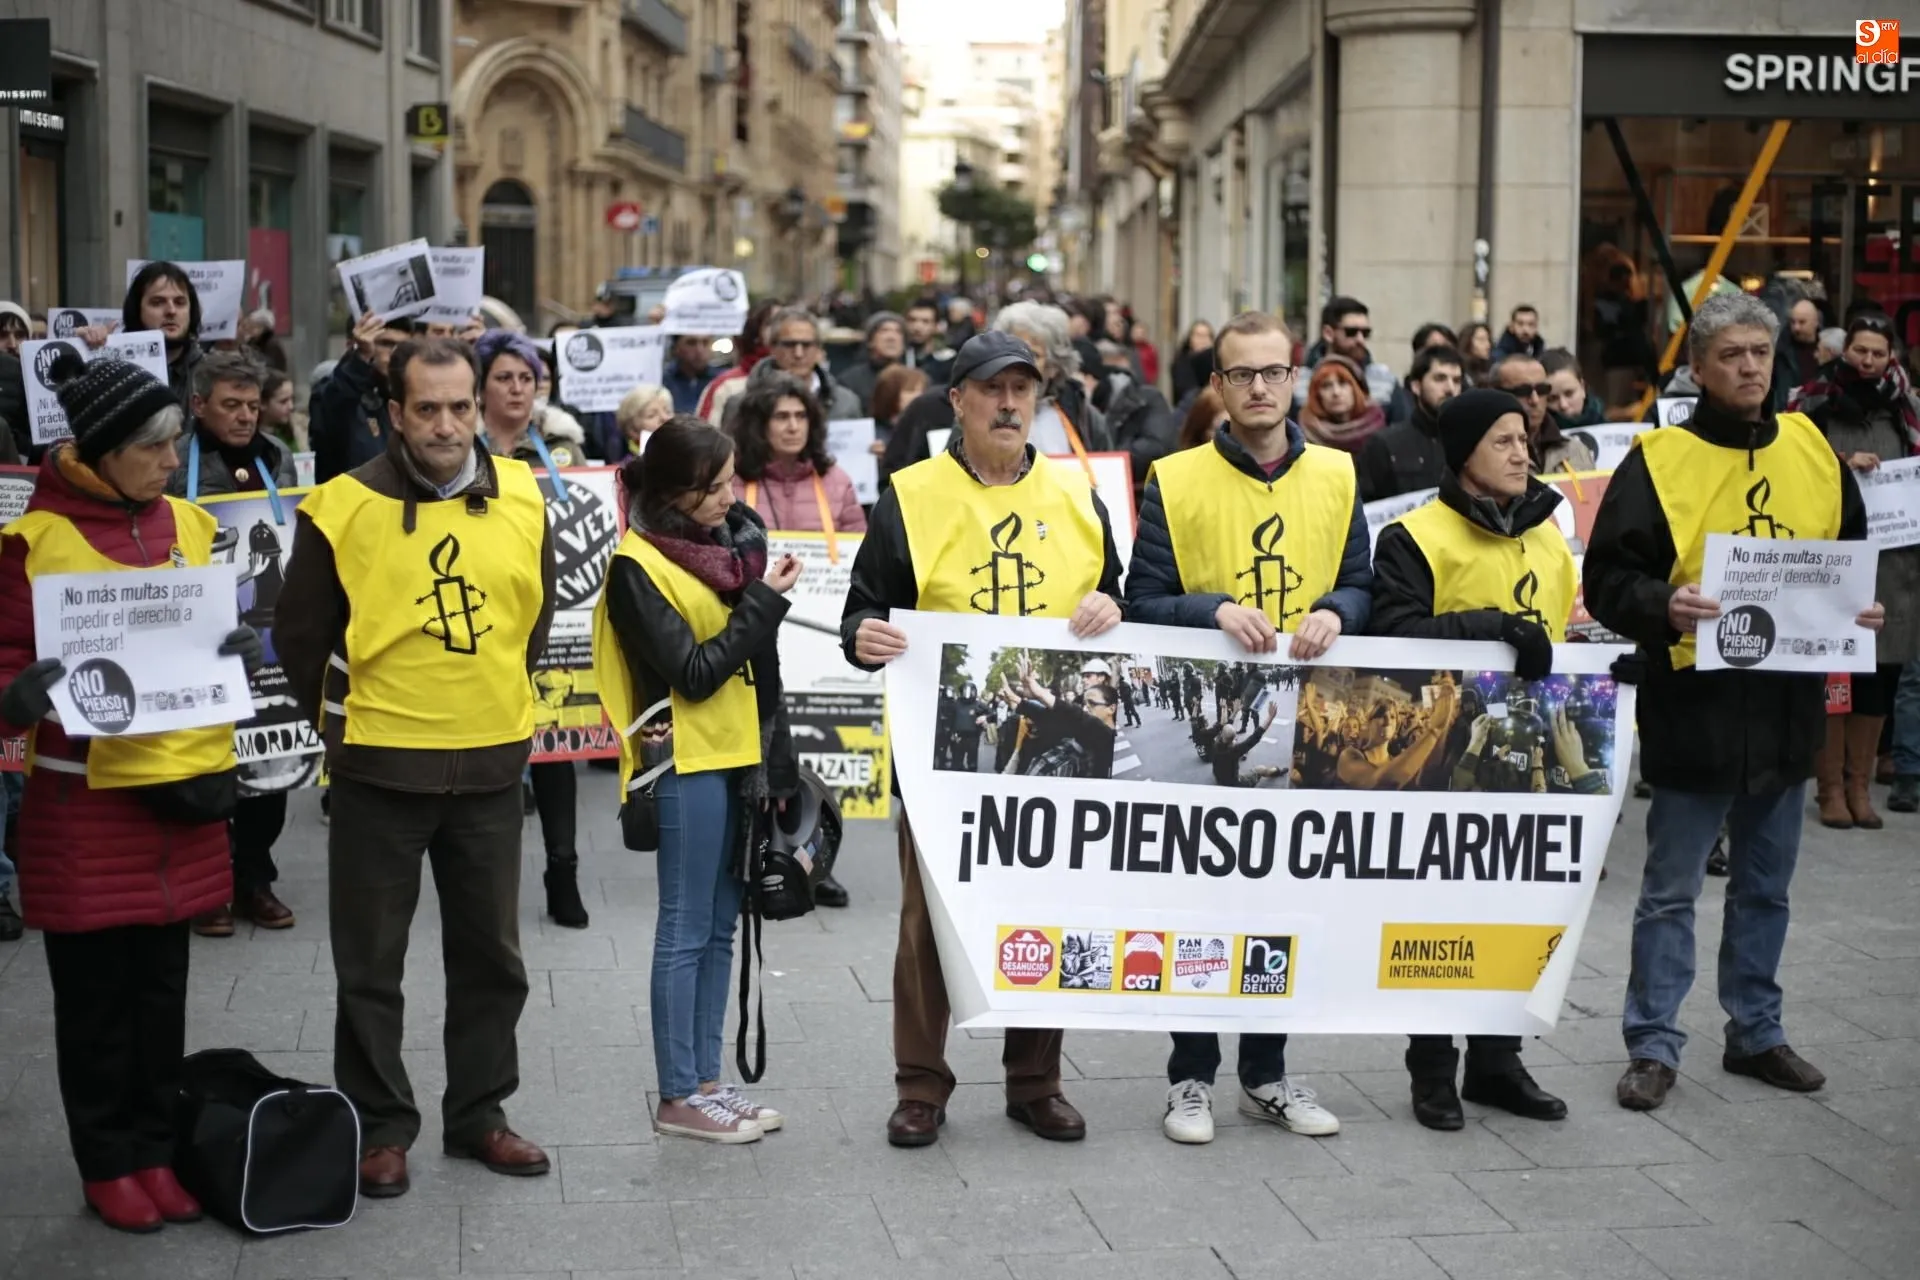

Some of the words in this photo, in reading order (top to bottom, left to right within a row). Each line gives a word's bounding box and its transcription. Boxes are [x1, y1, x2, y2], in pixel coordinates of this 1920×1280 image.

[1726, 547, 1750, 567] ¡No
[1753, 548, 1779, 564] más
[1782, 549, 1823, 566] multas
[1825, 554, 1852, 569] para
[1724, 568, 1770, 585] impedir
[1772, 568, 1782, 583] el
[1785, 567, 1830, 585] derecho
[1832, 573, 1841, 585] a
[60, 586, 83, 612] ¡No
[87, 584, 117, 604] más
[120, 582, 169, 602] multas
[172, 583, 203, 603] para
[1720, 586, 1778, 604] protestar!
[60, 611, 109, 632] impedir
[112, 610, 125, 627] el
[127, 605, 181, 625] derecho
[182, 611, 192, 622] a
[1720, 612, 1751, 639] ¡NO
[61, 634, 125, 659] protestar!
[1724, 635, 1761, 648] PIENSO
[70, 669, 105, 703] ¡NO
[82, 694, 123, 713] PIENSO
[958, 795, 1055, 882] ¡NO
[1069, 800, 1274, 880] PIENSO
[1288, 810, 1584, 884] CALLARME!
[1178, 938, 1202, 948] PAN
[1390, 935, 1475, 962] AMNISTÍA
[1003, 942, 1050, 963] STOP
[1178, 952, 1203, 960] TECHO
[1002, 961, 1050, 972] DESAHUCIOS
[1006, 970, 1043, 978] SALAMANCA
[1176, 961, 1228, 977] DIGNIDAD
[1388, 964, 1475, 979] INTERNACIONAL
[1124, 974, 1160, 990] CGT
[1243, 973, 1286, 984] SOMOS
[1242, 983, 1285, 994] DELITO
